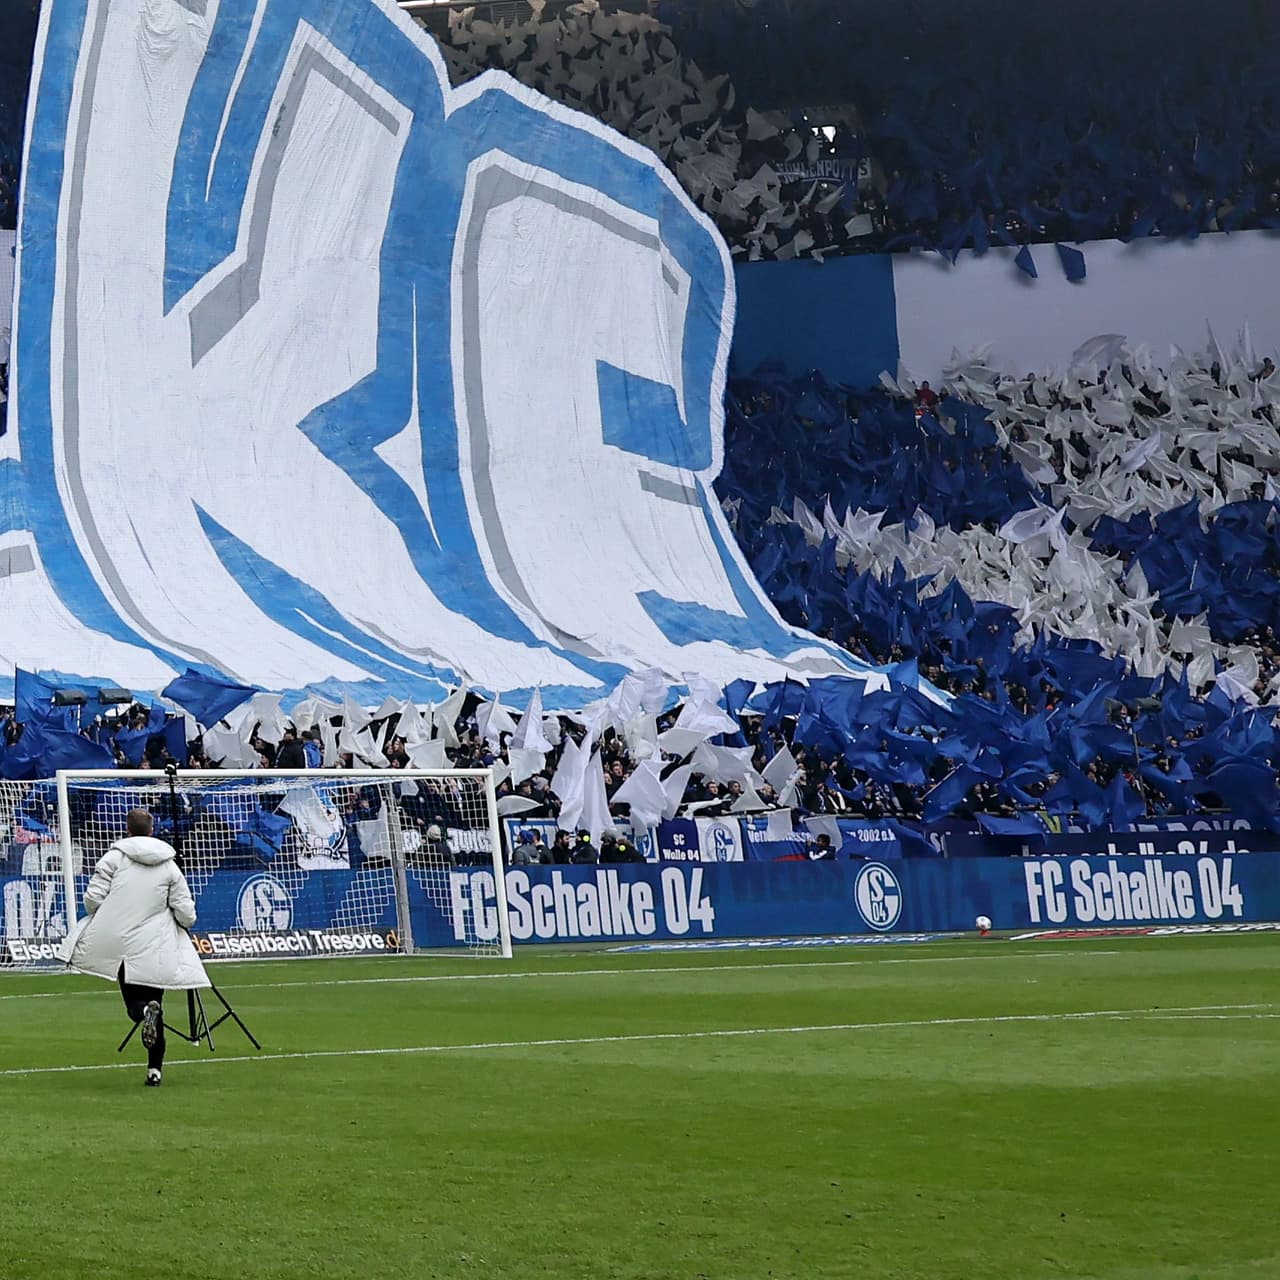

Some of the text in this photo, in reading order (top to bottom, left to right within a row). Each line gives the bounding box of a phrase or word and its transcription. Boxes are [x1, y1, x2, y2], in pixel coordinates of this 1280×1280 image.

[672, 833, 686, 846] SC
[858, 829, 880, 842] 2002
[686, 849, 700, 861] 04
[1023, 857, 1244, 923] FC Schalke 04
[449, 868, 715, 941] FC Schalke 04
[209, 931, 315, 954] Eisenbach
[310, 929, 401, 952] Tresore.d
